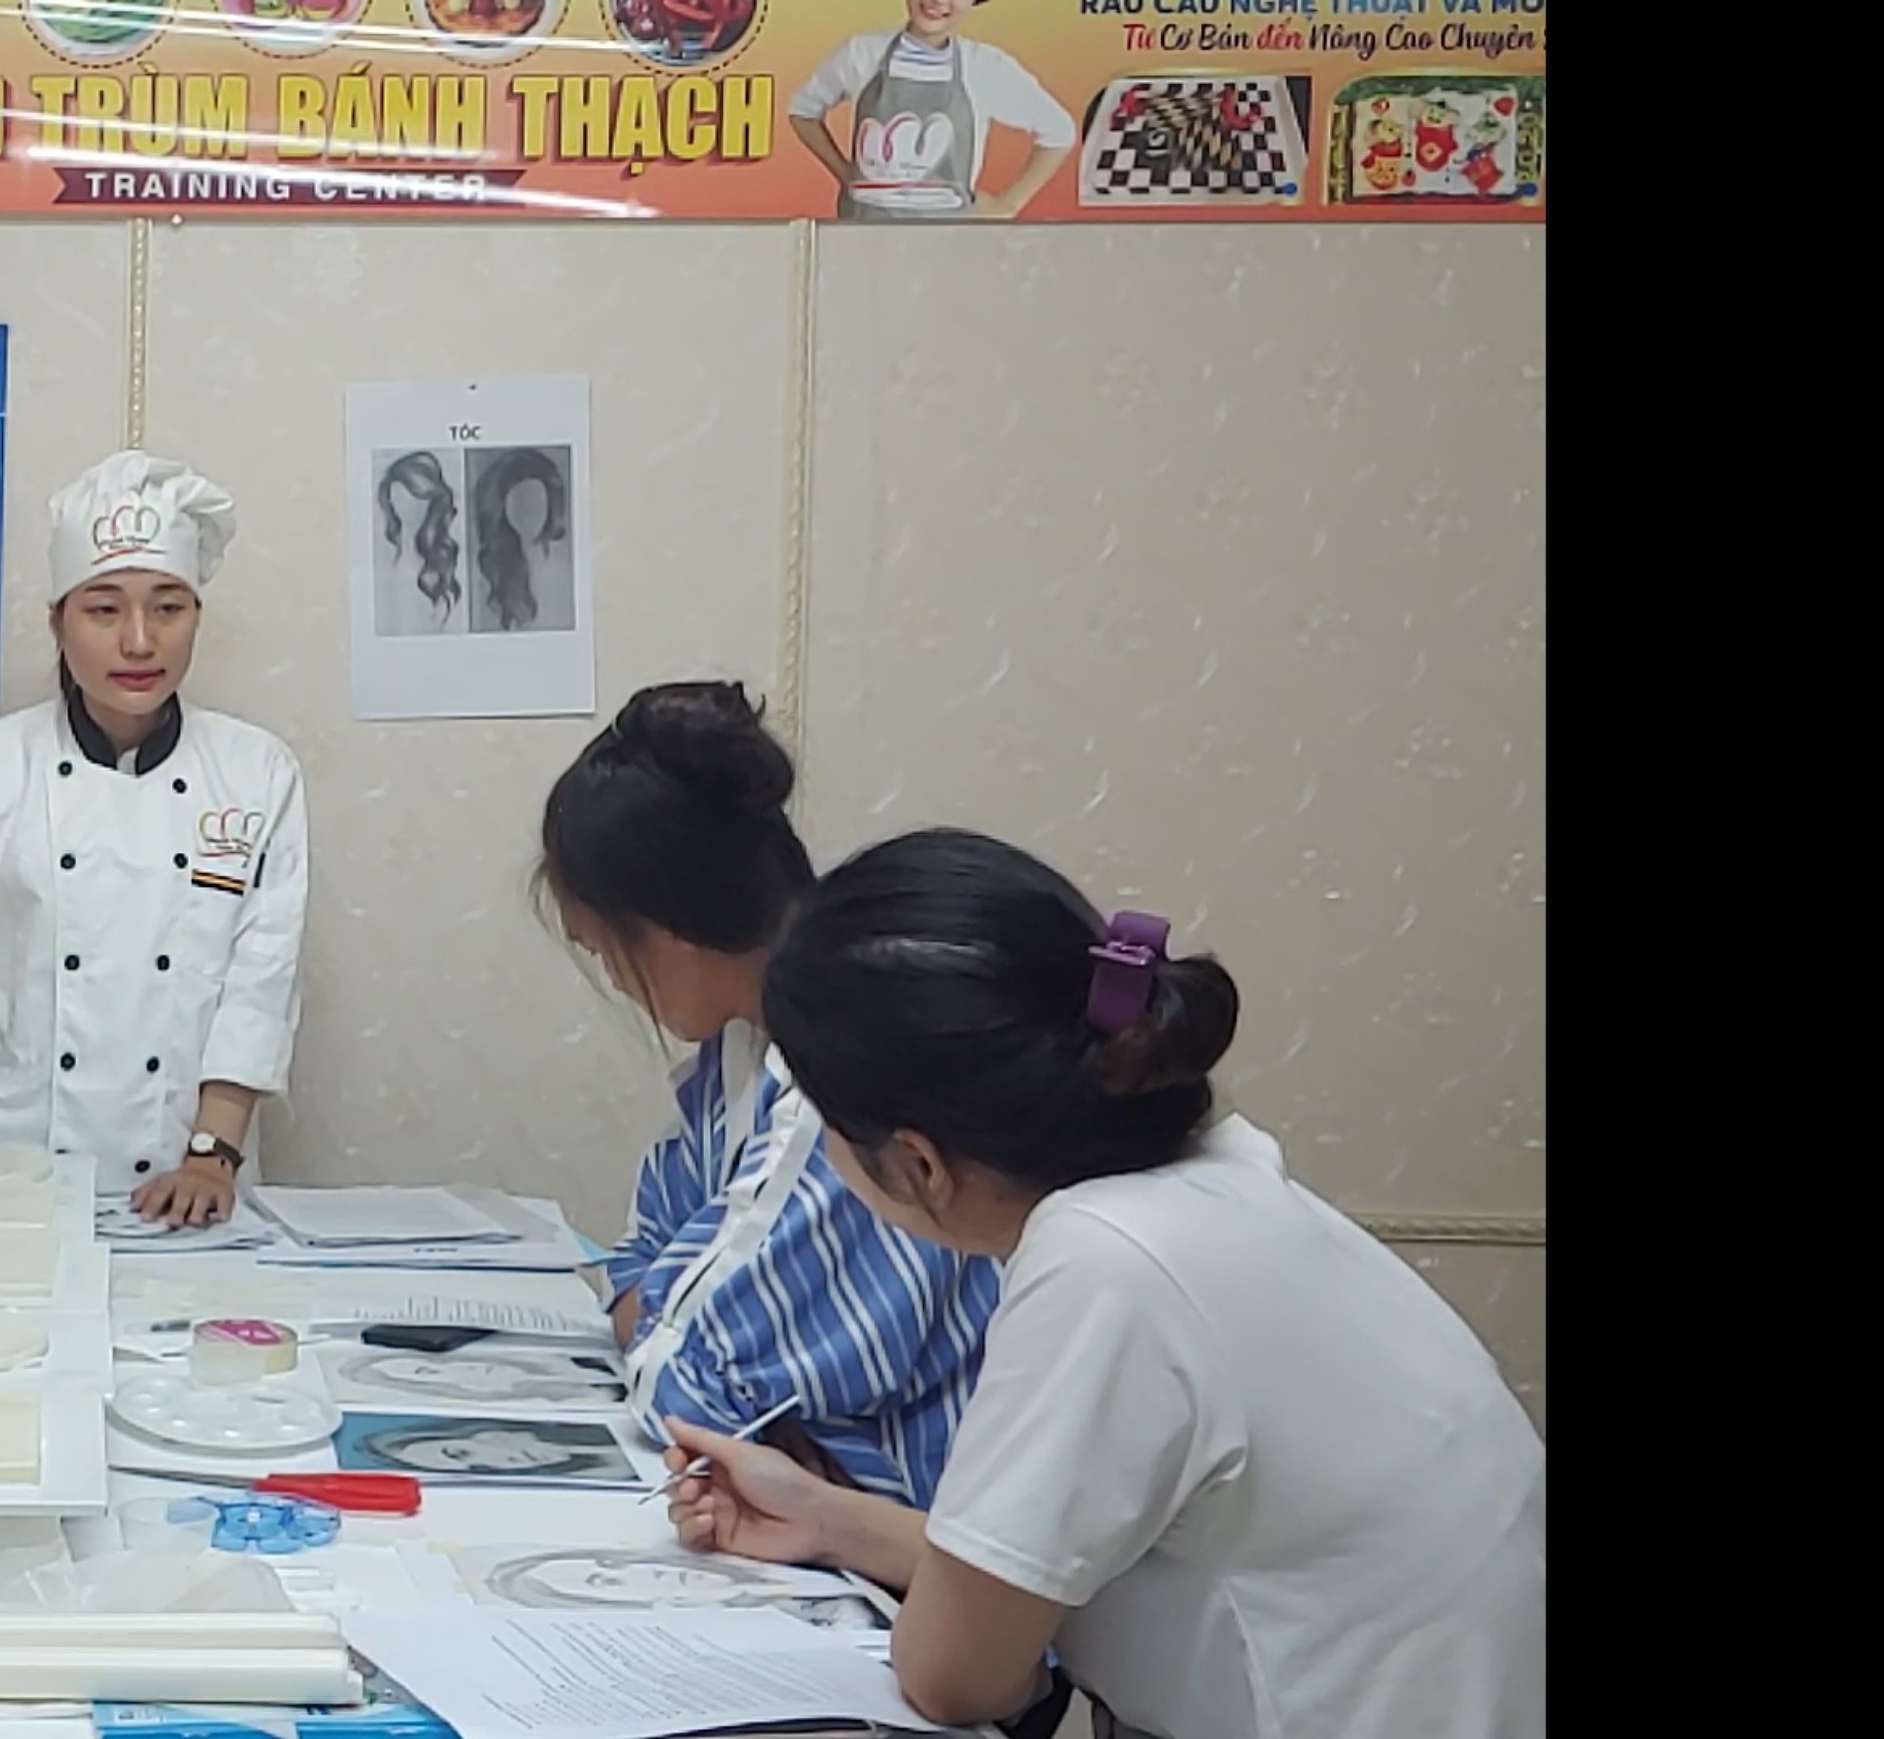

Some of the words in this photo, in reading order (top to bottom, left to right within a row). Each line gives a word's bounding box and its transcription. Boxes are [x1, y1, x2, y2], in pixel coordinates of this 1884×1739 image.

[1385, 23, 1434, 51] Cao
[32, 61, 249, 157] TRÙM
[279, 61, 487, 158] BÁNH
[515, 75, 773, 174] THẠCH
[85, 171, 291, 199] TRAINING
[449, 423, 481, 441] TÓC
